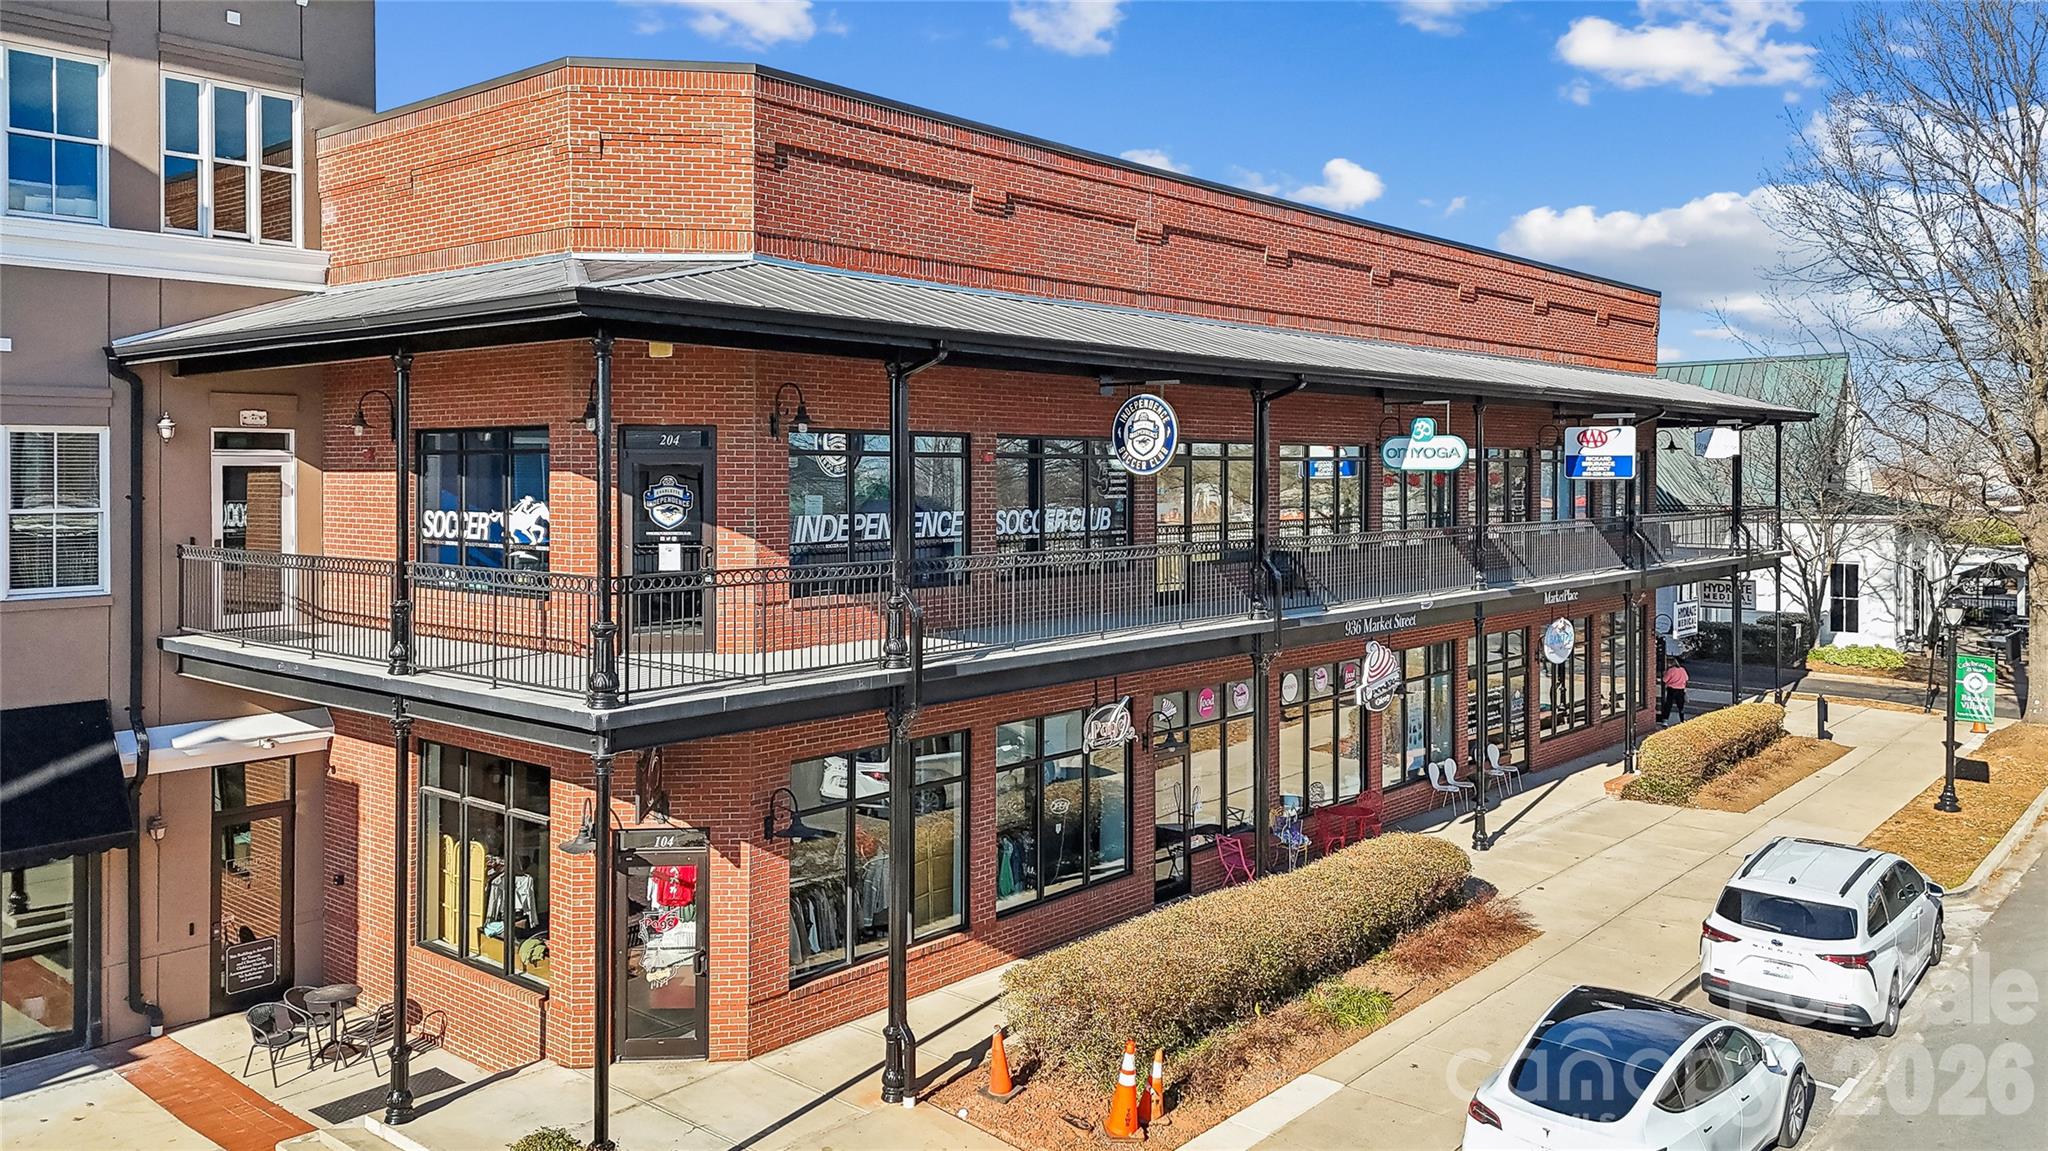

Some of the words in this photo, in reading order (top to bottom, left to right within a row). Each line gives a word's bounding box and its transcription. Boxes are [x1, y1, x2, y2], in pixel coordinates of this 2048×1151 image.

[1119, 399, 1170, 423] INDEPENDENCE
[659, 434, 680, 446] 204
[1579, 430, 1606, 447] AAA
[1118, 446, 1147, 470] SOCCER
[1149, 447, 1169, 468] CLUB
[646, 495, 691, 508] INDEPENDENCE
[793, 511, 965, 544] INDEPENENCE
[1703, 582, 1752, 595] HYDRTE
[1703, 592, 1752, 602] MEDIAL
[1678, 605, 1697, 619] HYDRATE
[1345, 619, 1362, 637] 936
[1363, 615, 1393, 634] Market
[1393, 613, 1417, 629] Street
[1678, 618, 1697, 628] MEDICAL
[654, 836, 675, 848] 104
